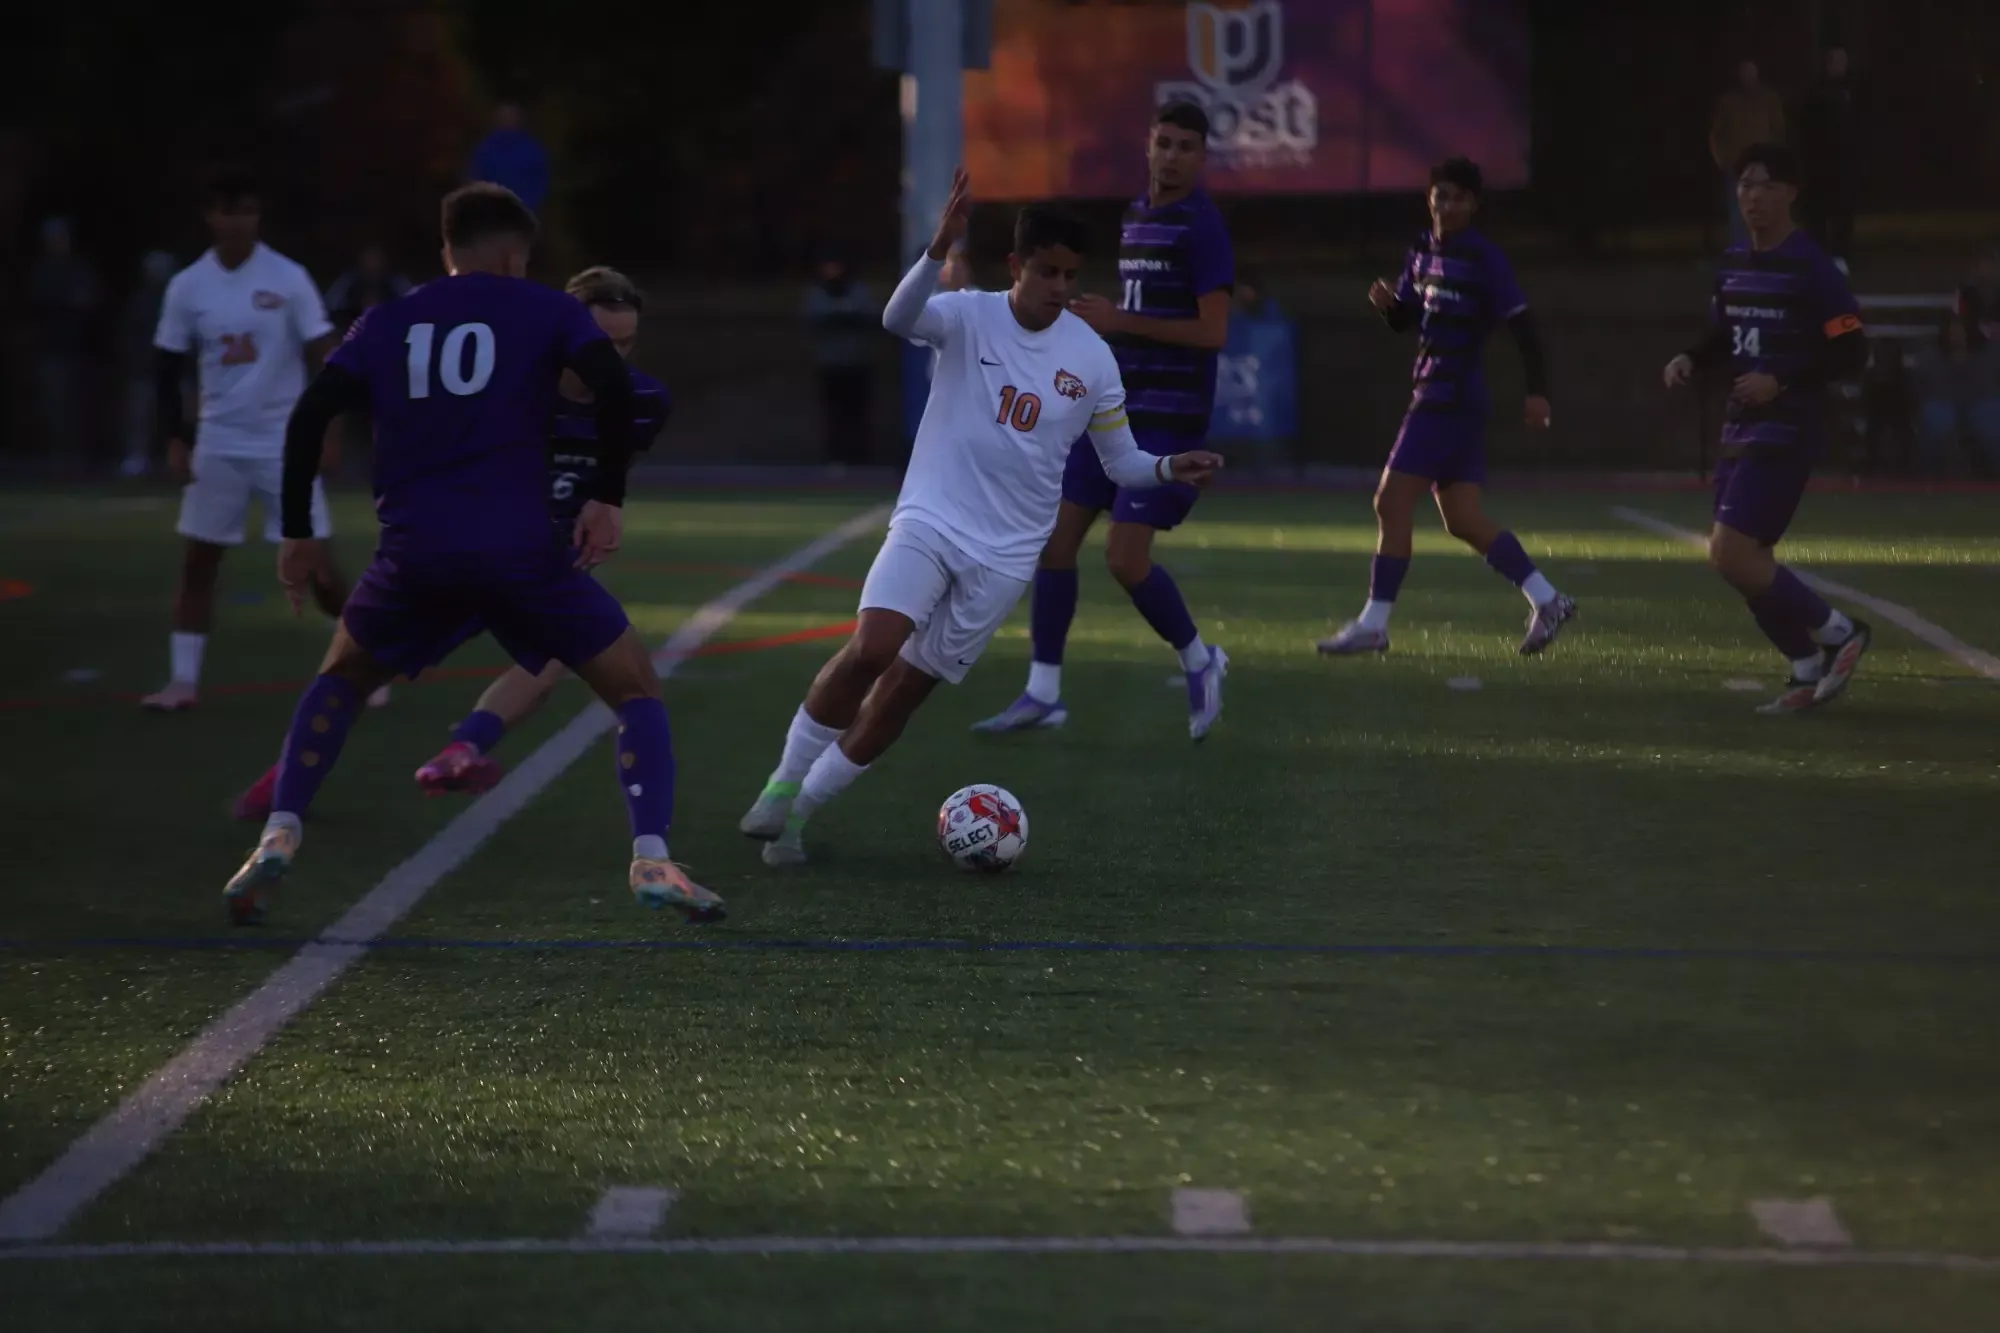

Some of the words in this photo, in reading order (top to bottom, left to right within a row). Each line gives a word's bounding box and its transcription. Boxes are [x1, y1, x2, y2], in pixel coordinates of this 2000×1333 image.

[404, 321, 496, 400] 10
[1731, 324, 1760, 357] 34
[996, 384, 1042, 432] 10
[947, 823, 994, 855] SELECT
